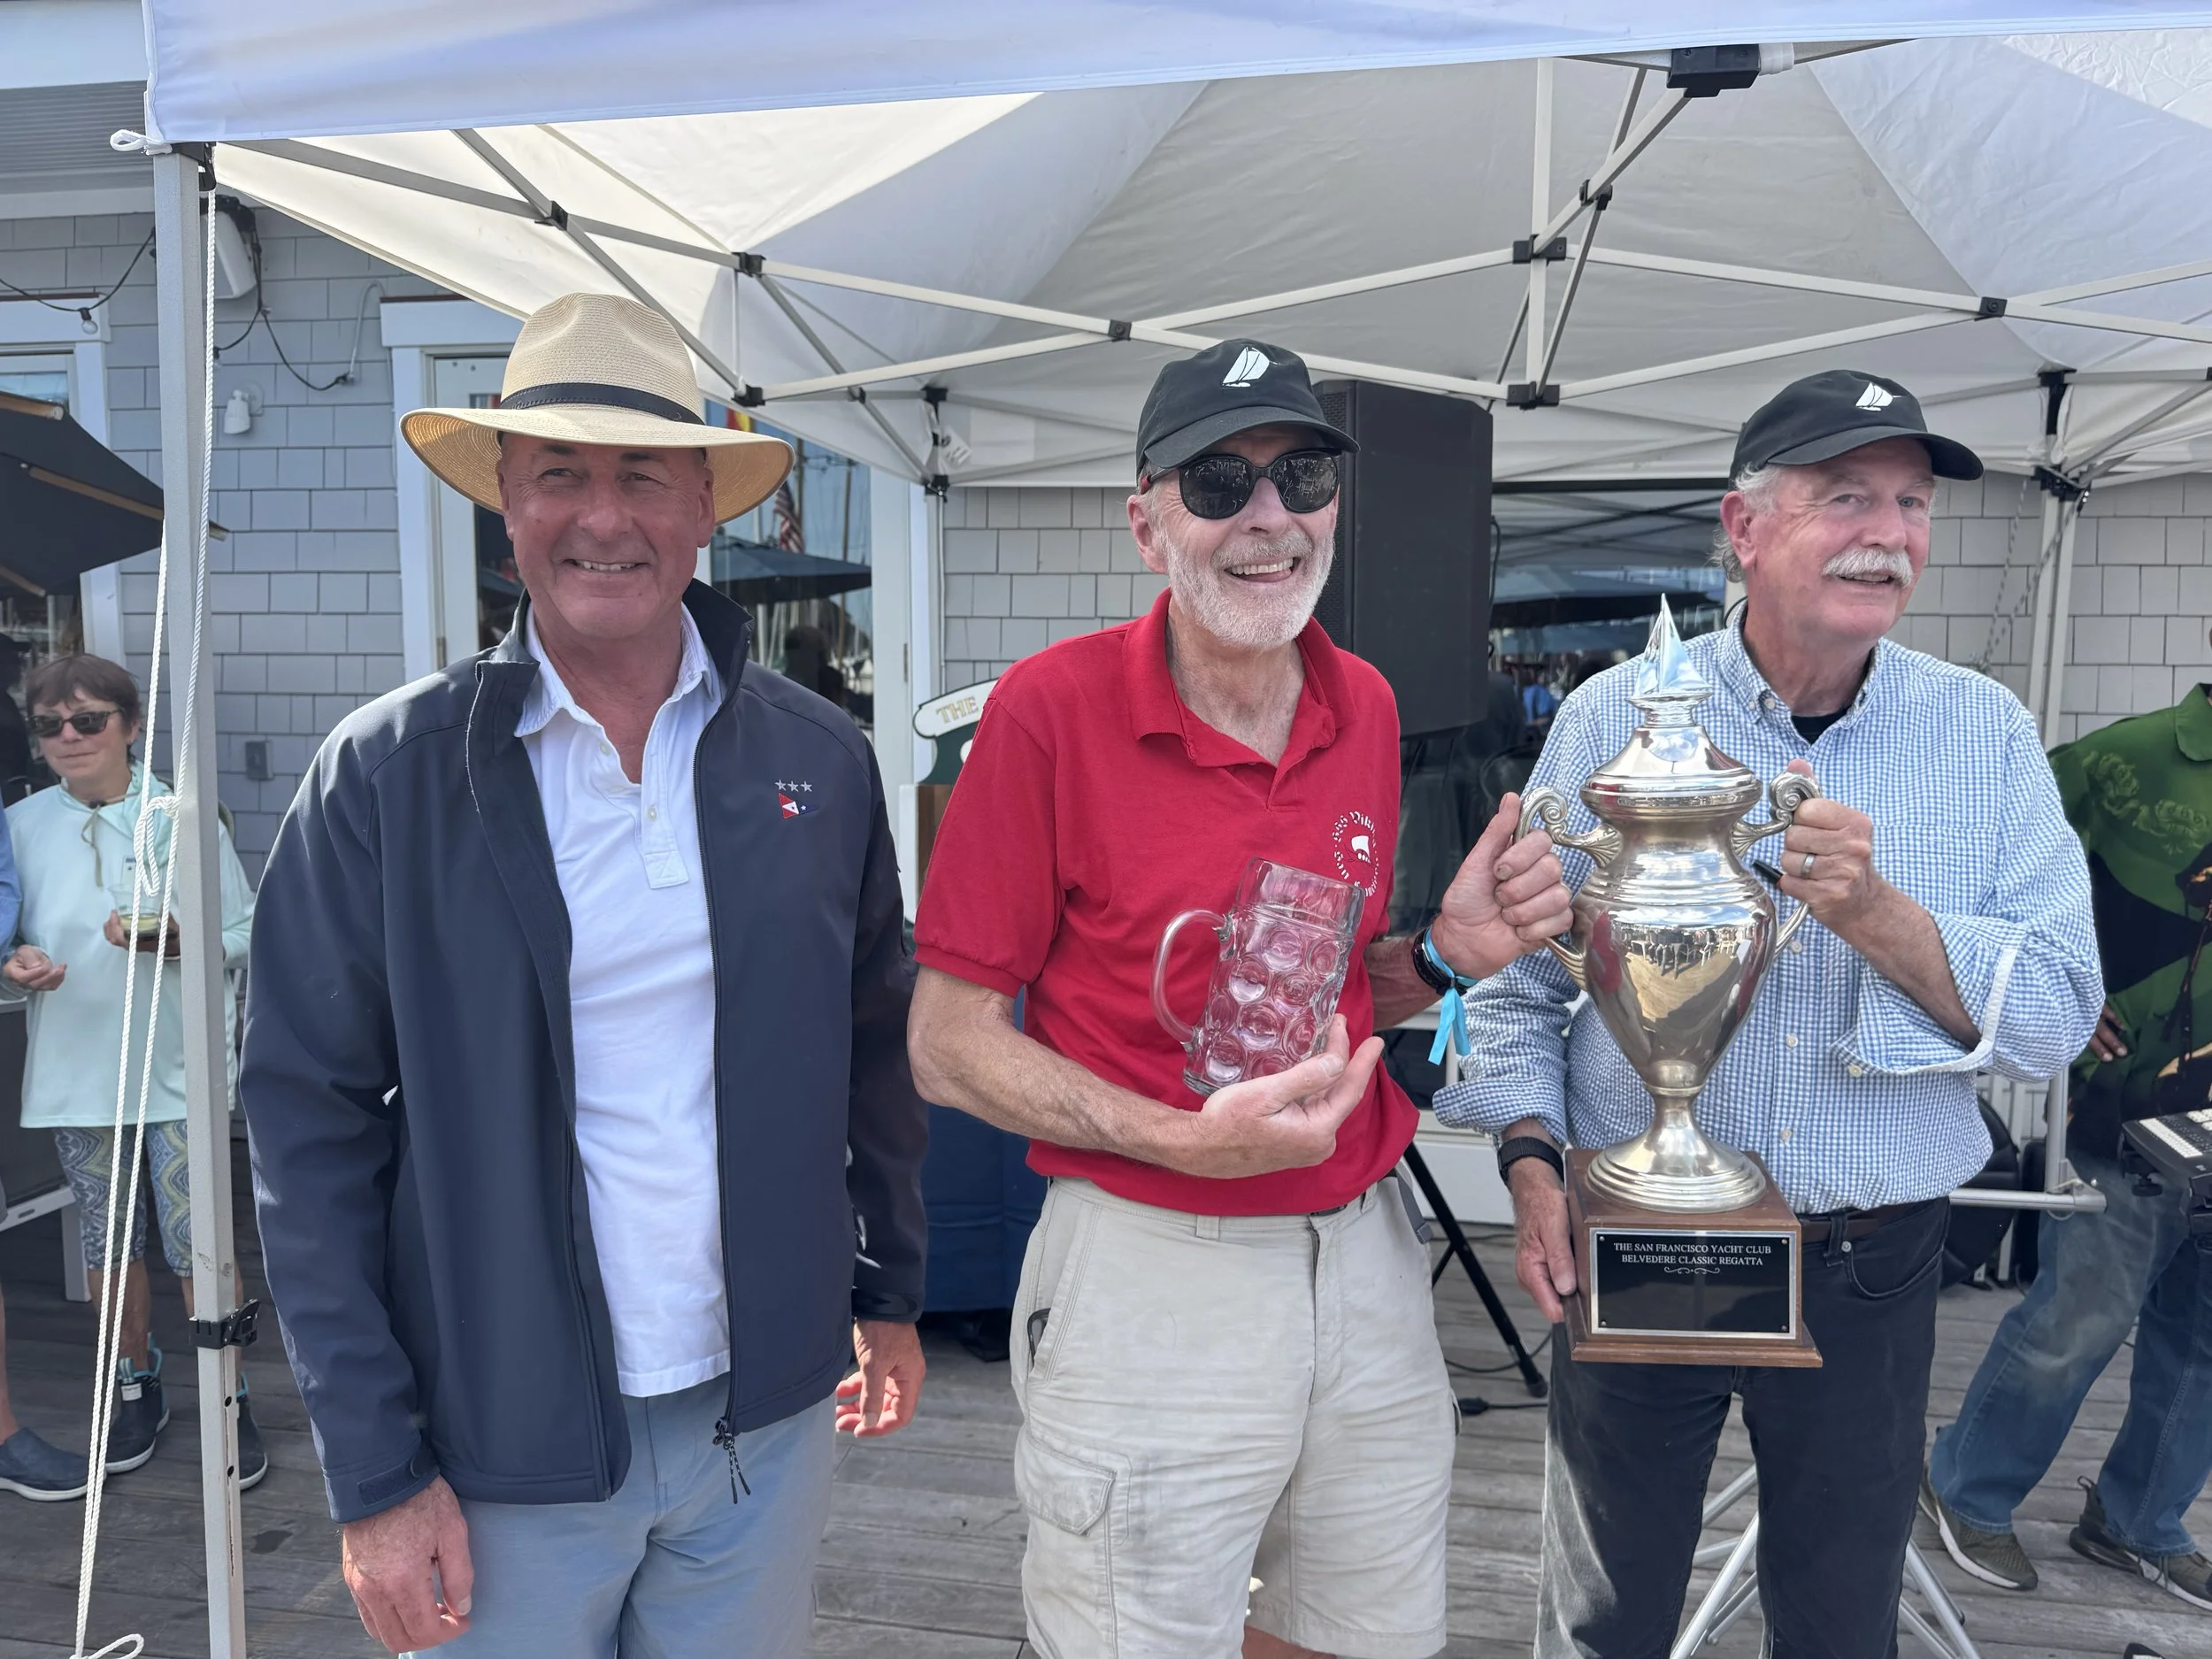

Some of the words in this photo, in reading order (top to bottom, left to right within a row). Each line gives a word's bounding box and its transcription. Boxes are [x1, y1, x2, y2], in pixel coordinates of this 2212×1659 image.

[936, 696, 979, 724] THE
[1613, 1242, 1633, 1252] THE
[1634, 1242, 1654, 1252] SAN
[1655, 1243, 1709, 1254] FRANCISCO
[1710, 1244, 1744, 1254] YACHT
[1746, 1245, 1771, 1255] CLUB
[1622, 1254, 1677, 1264] BELVEDERE
[1678, 1255, 1717, 1265] CLASSIC
[1718, 1256, 1763, 1266] REGATTA
